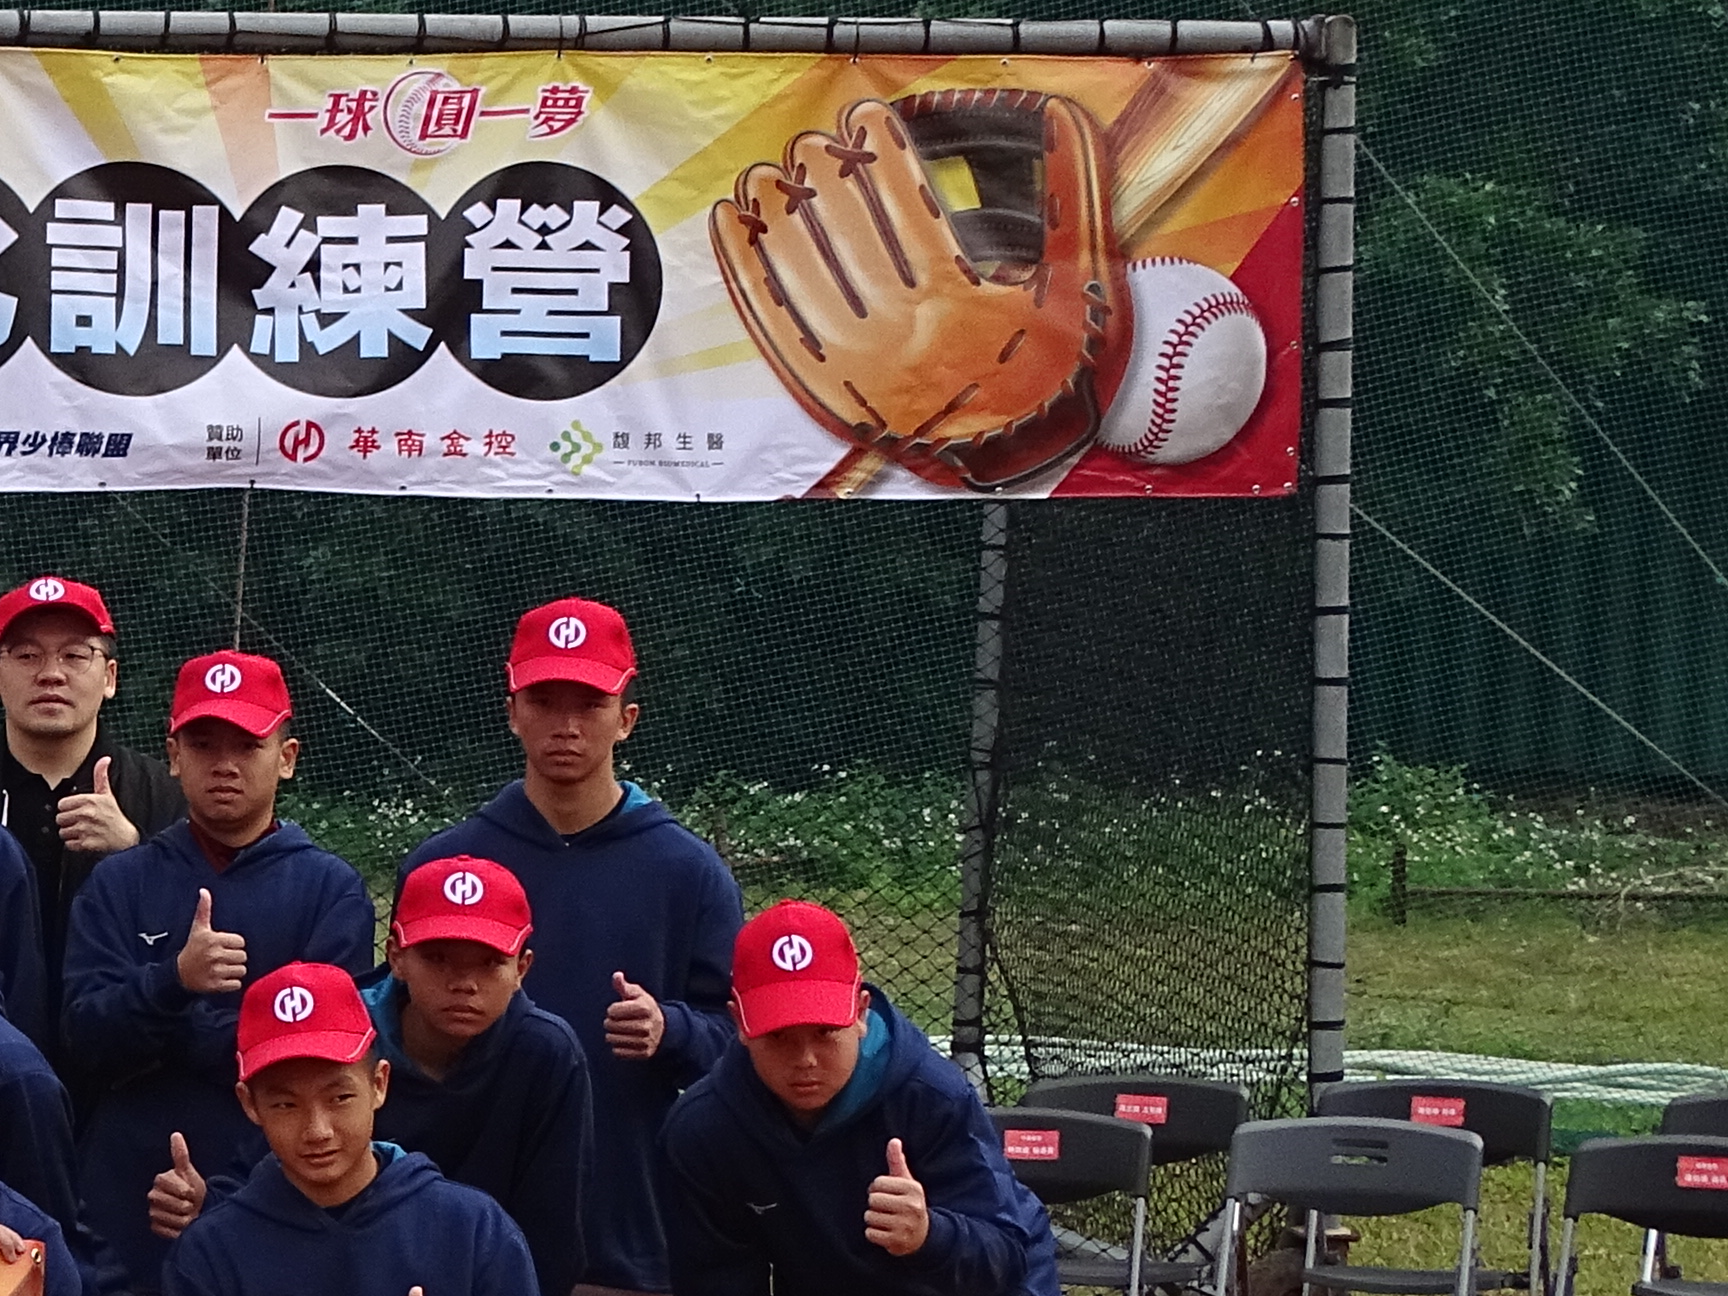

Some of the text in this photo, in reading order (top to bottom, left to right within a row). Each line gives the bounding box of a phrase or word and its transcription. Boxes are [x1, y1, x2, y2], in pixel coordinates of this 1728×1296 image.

[267, 84, 590, 142] 一球圓一夢
[205, 445, 243, 463] 單位
[348, 426, 517, 461] 華南金控
